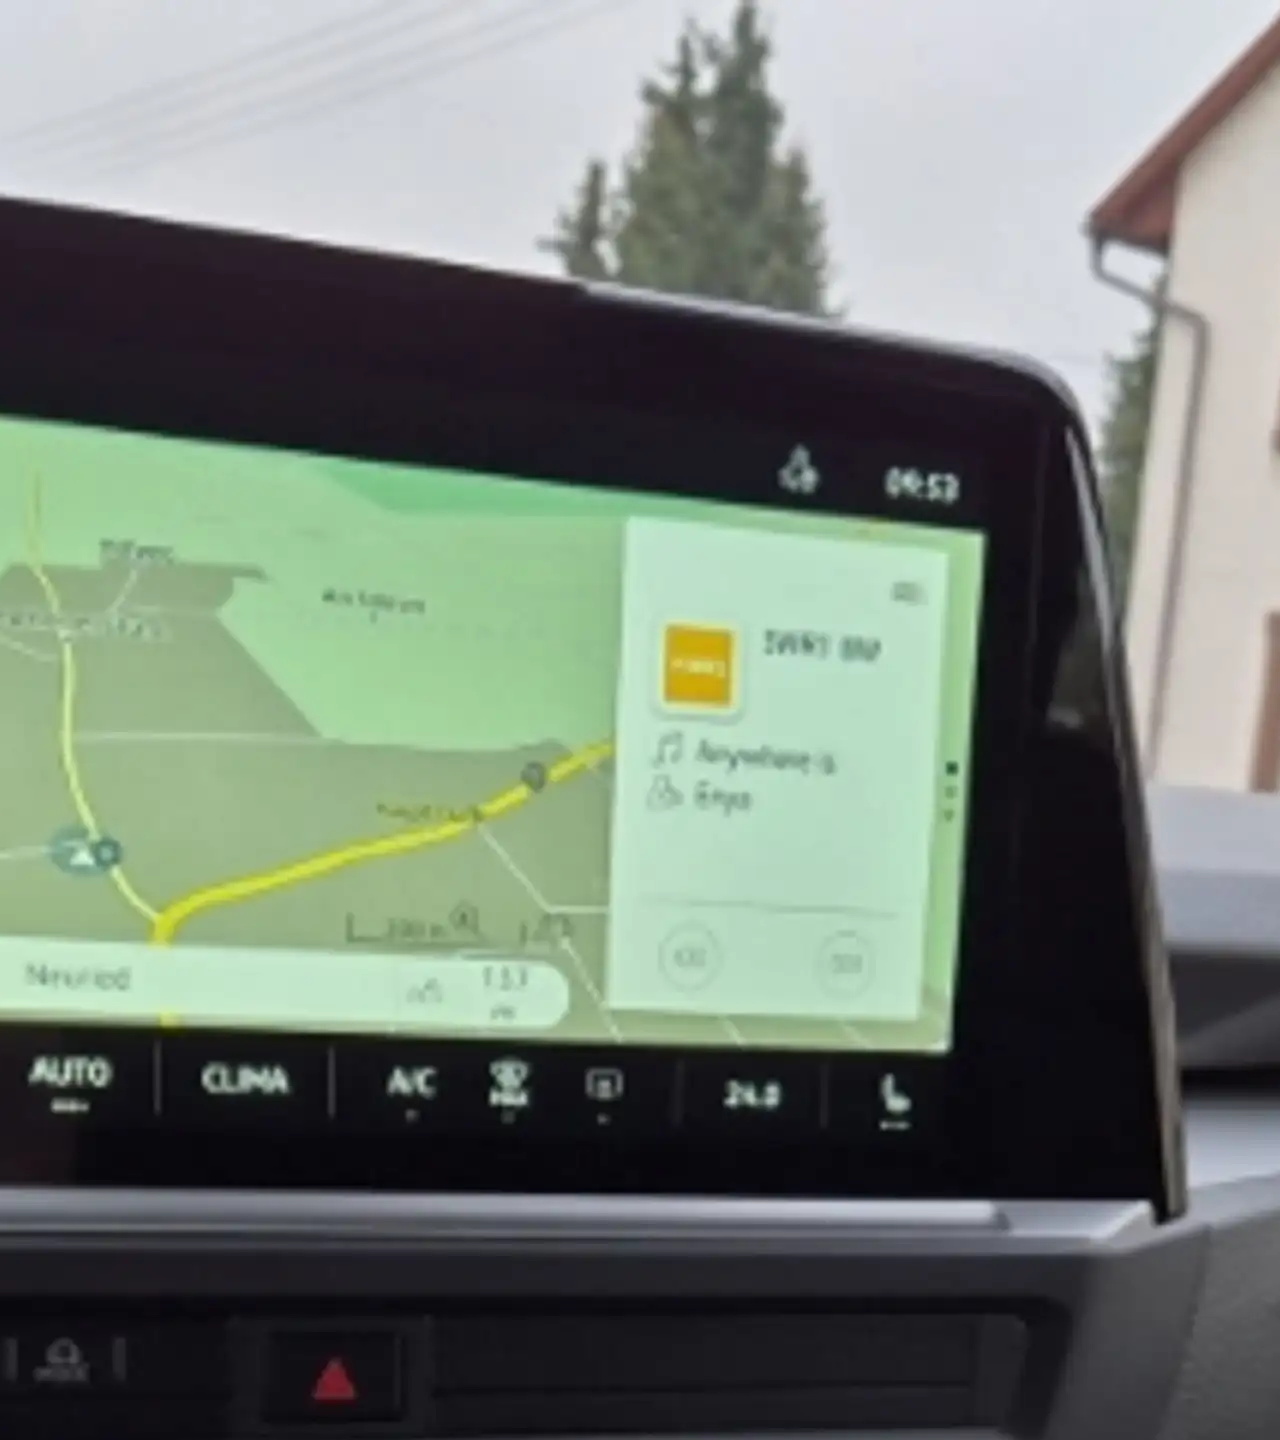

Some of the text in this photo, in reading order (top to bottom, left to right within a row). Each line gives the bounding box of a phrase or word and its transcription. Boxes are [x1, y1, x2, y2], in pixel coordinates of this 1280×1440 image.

[27, 1056, 113, 1089] AUTO
[199, 1062, 290, 1095] CLIMA
[387, 1066, 438, 1098] A/C
